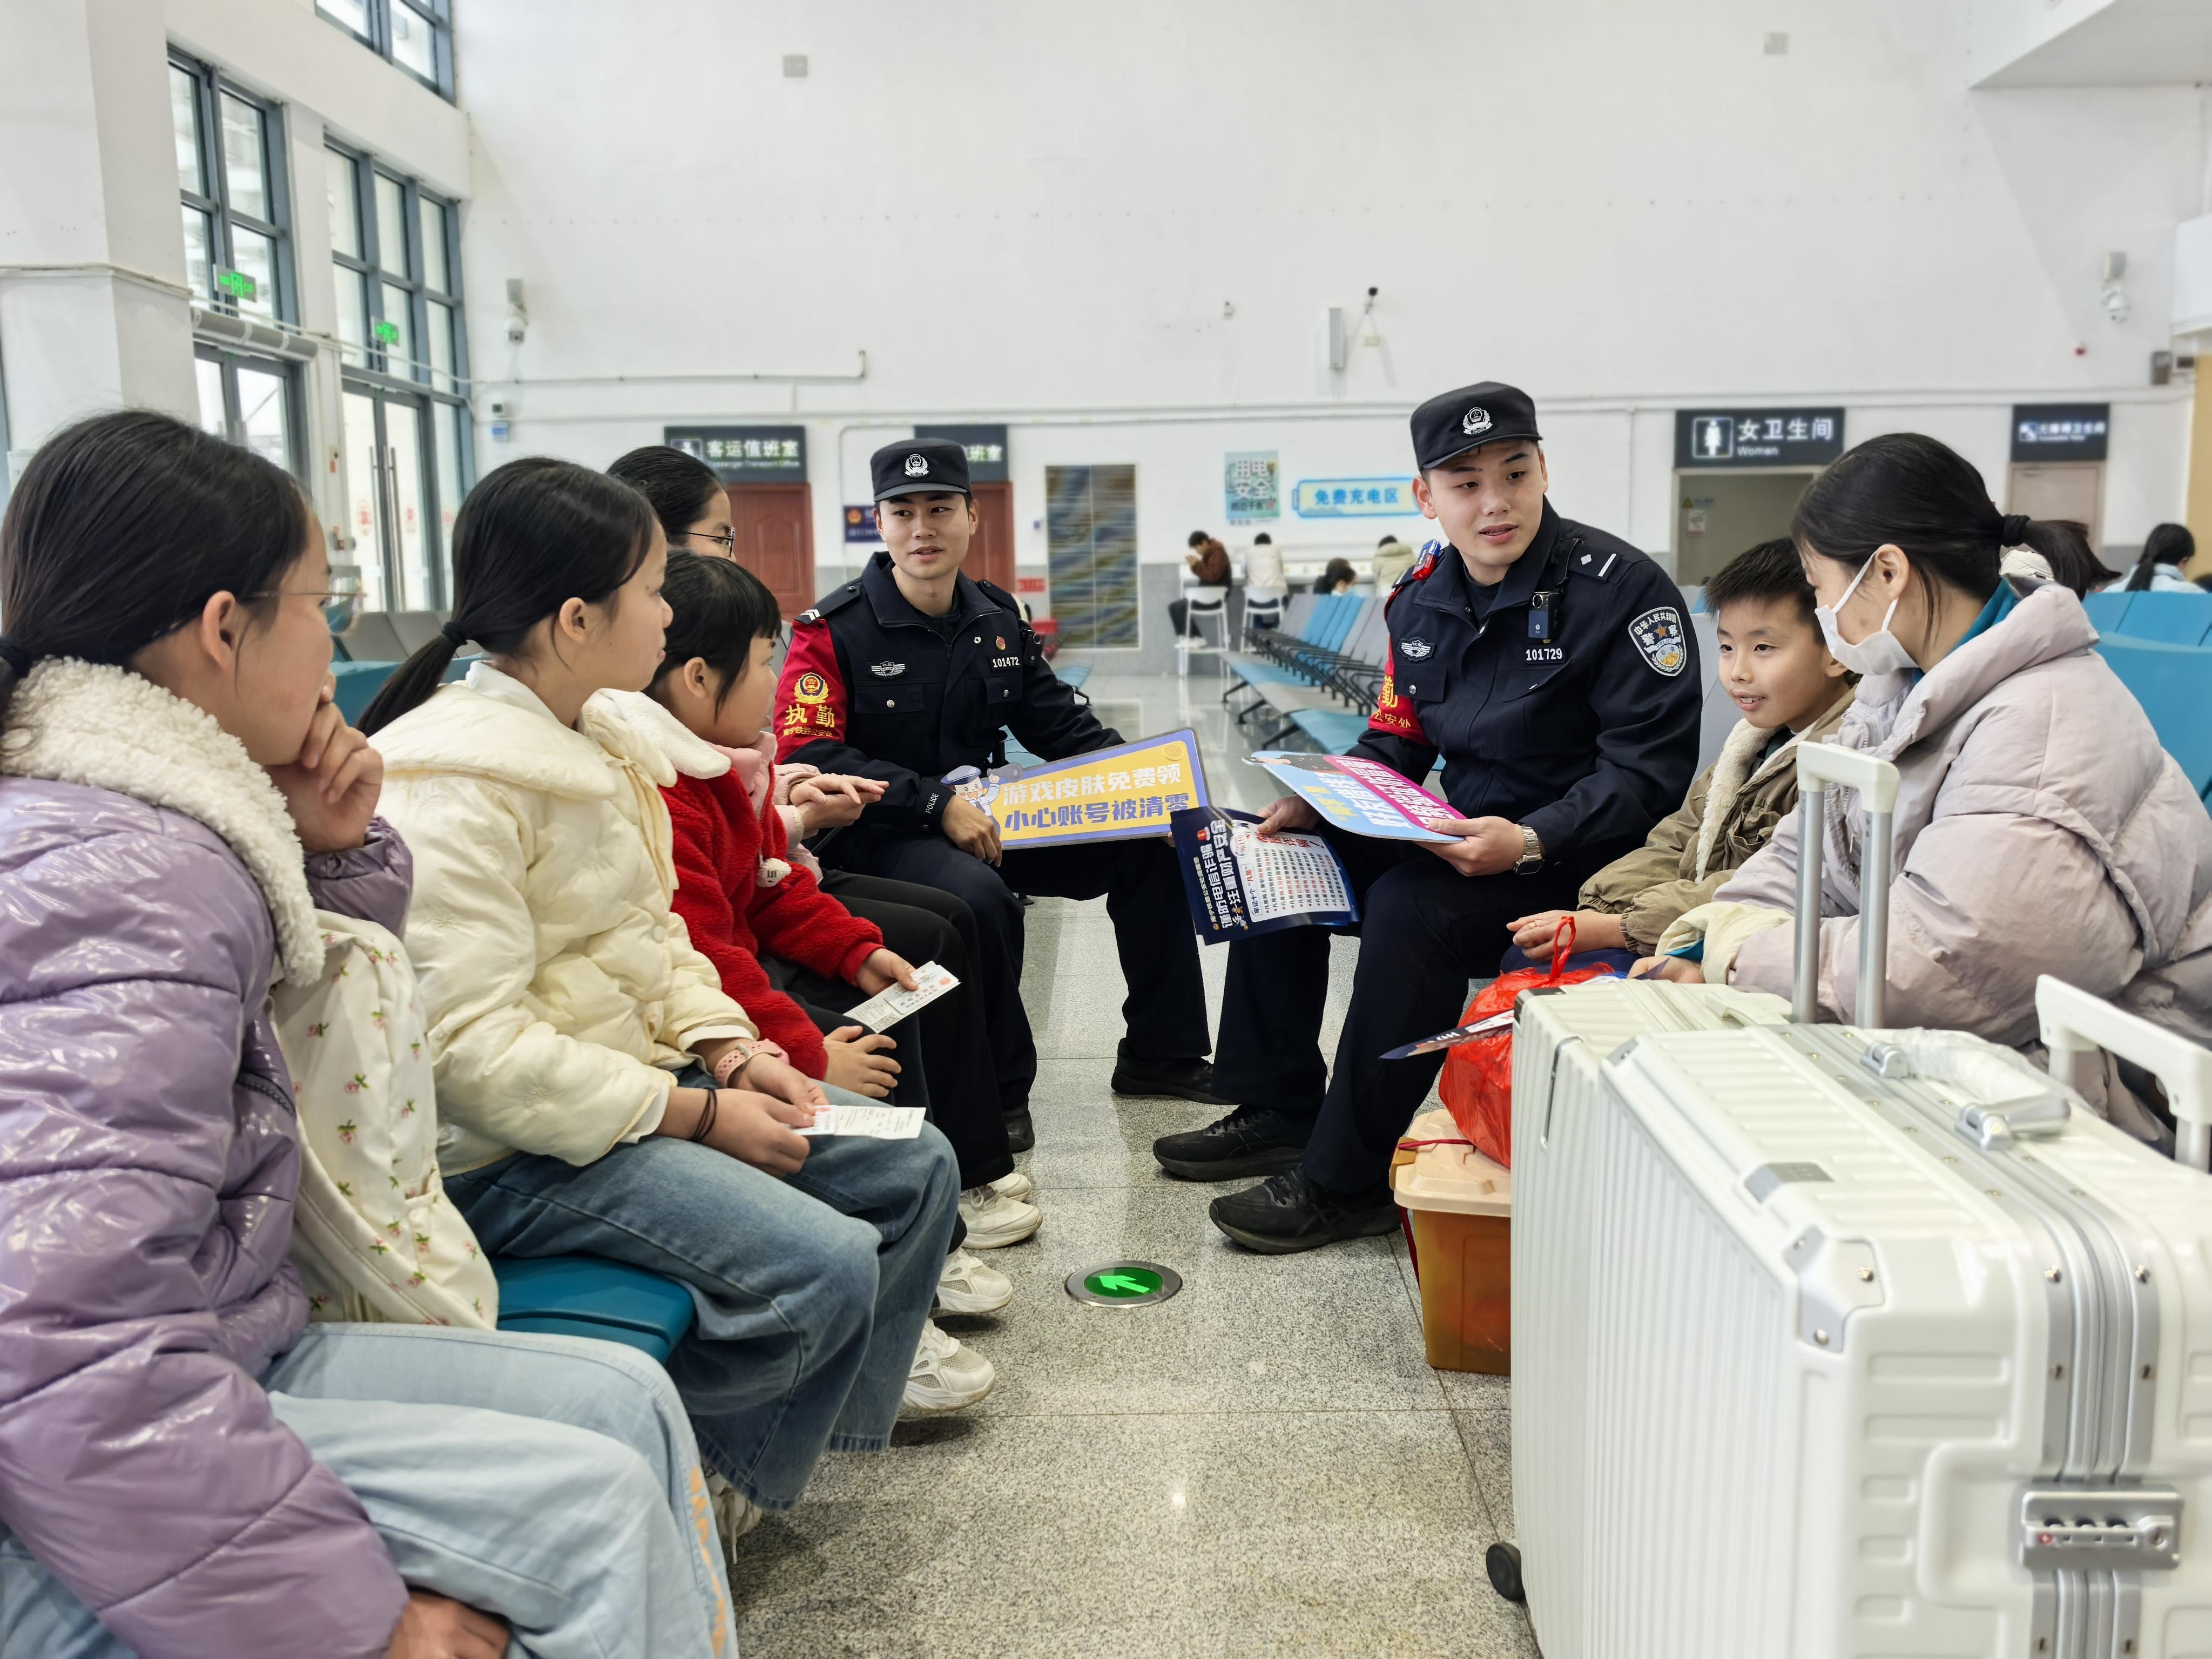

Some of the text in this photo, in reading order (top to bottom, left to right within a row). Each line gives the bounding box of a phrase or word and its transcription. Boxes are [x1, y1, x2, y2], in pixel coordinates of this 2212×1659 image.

[1738, 419, 1833, 441] 女卫生间
[707, 440, 799, 457] 客运值班室
[966, 444, 1002, 461] 班室
[1737, 446, 1778, 456] Women
[1235, 458, 1267, 477] 用电
[1235, 479, 1270, 499] 安全
[1314, 488, 1399, 504] 免费充电区
[1634, 612, 1676, 635] 中华人民共和国
[1656, 638, 1673, 648] POLICE
[993, 656, 1020, 668] 101472
[1526, 648, 1563, 661] 101729
[1380, 675, 1398, 707] 勤
[784, 703, 835, 728] 执勤
[1372, 709, 1411, 729] 公安处
[1003, 763, 1181, 807] 游戏皮肤免费领
[925, 792, 939, 814] POLICE
[1004, 793, 1189, 832] 小心账号被清零
[1210, 819, 1240, 905] 注重财产安全
[1200, 843, 1233, 929] 谨防电信诈骗
